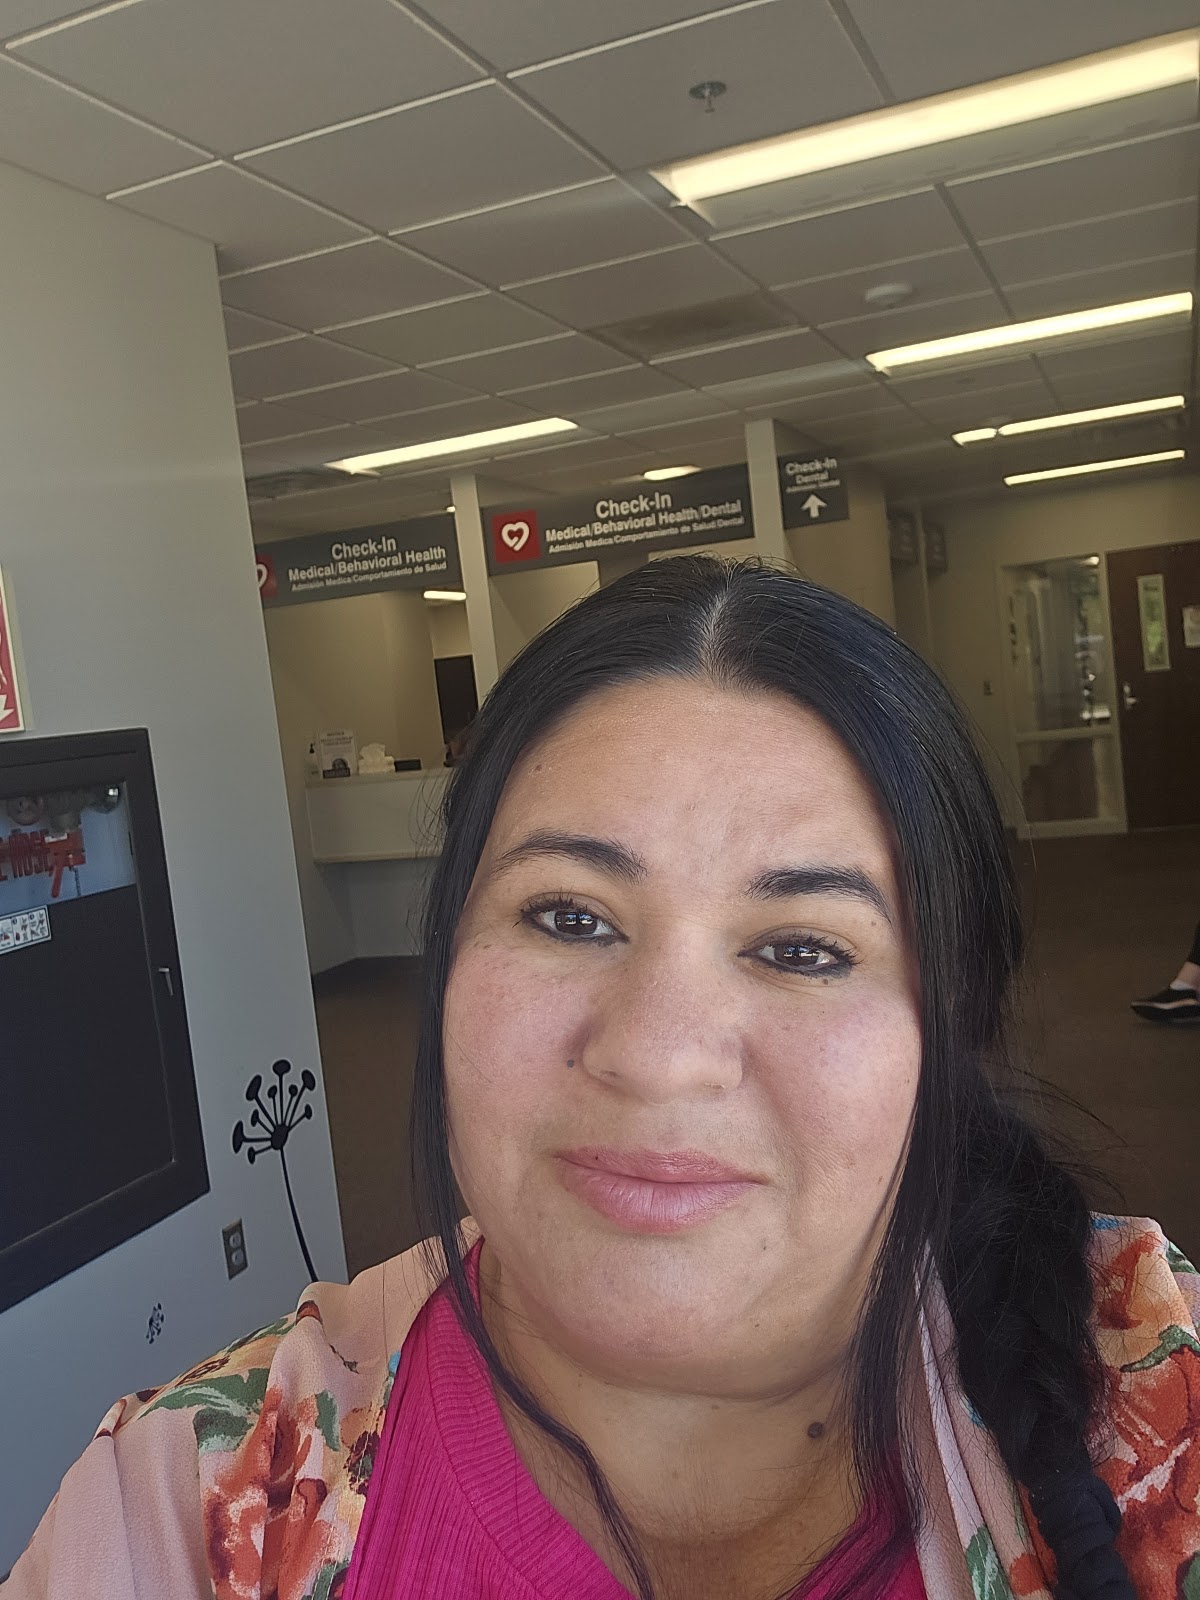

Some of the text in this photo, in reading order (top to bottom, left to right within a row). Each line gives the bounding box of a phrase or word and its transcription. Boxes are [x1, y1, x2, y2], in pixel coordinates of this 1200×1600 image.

[595, 491, 672, 519] Check-In
[331, 536, 397, 560] Check-In
[405, 546, 447, 564] Health
[414, 565, 424, 574] de
